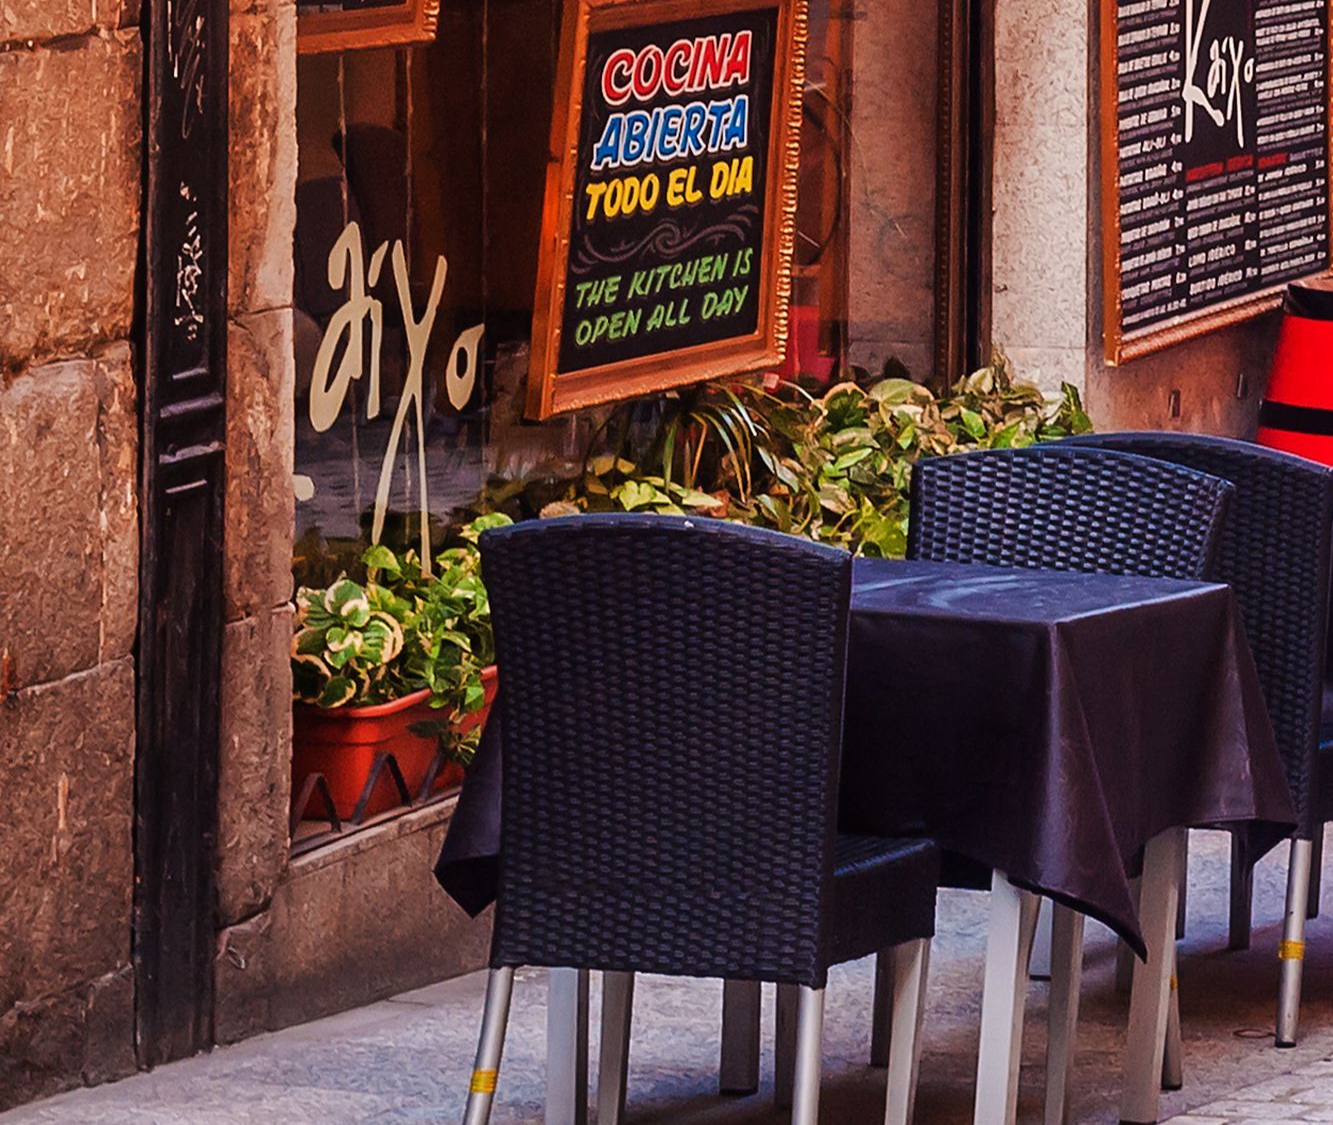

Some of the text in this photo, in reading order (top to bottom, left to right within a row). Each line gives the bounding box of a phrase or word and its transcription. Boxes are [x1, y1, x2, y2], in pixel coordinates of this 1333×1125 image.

[602, 30, 753, 106] COCINA
[591, 94, 749, 171] ABIERTA
[585, 156, 754, 220] TODO EL DIA
[576, 247, 754, 309] THE KITCHEN IS
[575, 285, 750, 347] OPEN ALL DAY
[295, 221, 486, 579] aixo
